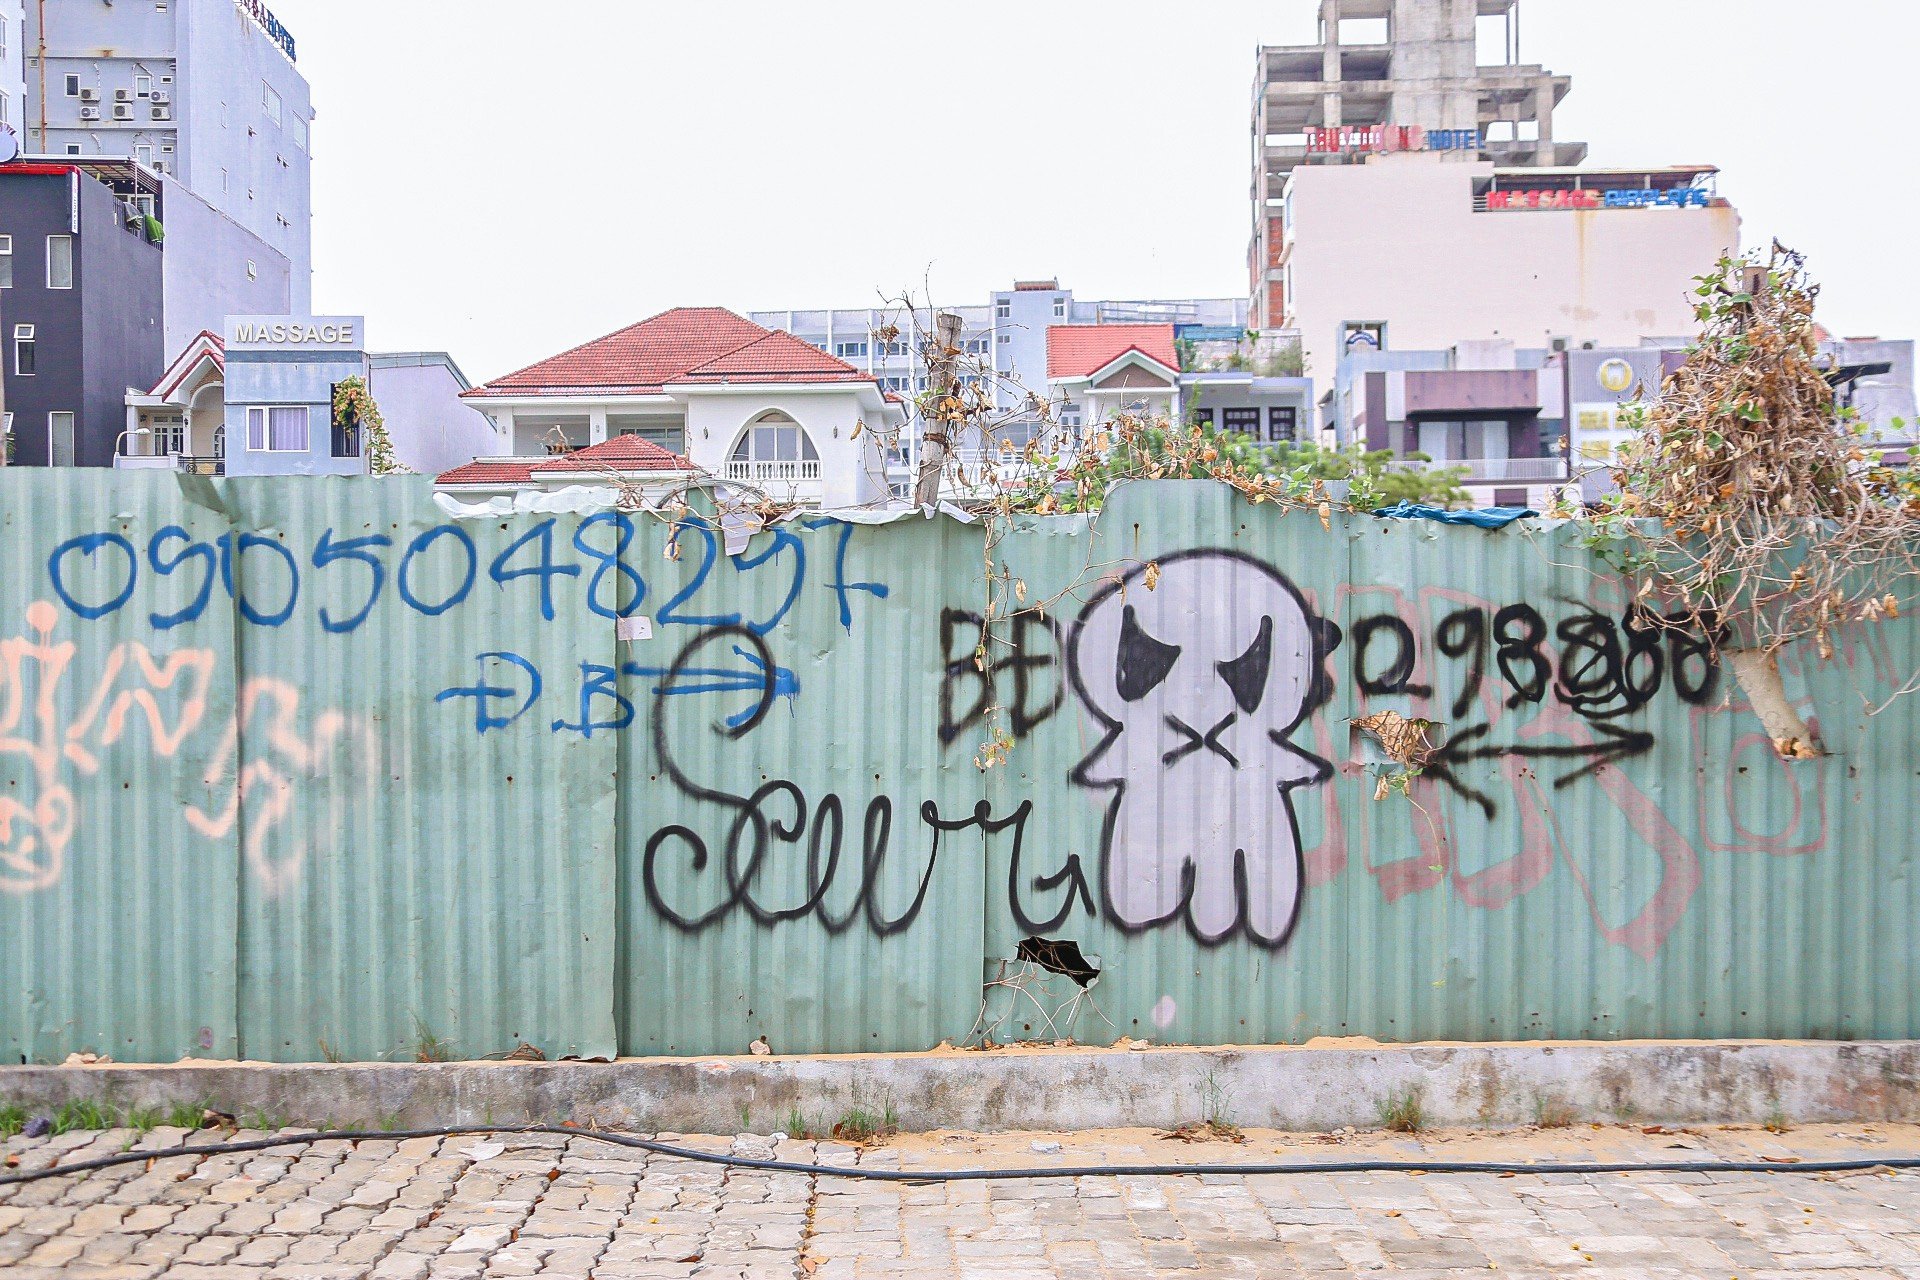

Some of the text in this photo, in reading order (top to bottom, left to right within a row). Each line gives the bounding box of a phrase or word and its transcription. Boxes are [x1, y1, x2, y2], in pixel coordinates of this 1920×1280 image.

[266, 8, 296, 62] HOTEL
[1428, 129, 1486, 150] HOTEL
[1486, 189, 1599, 209] MASSAGE
[235, 323, 354, 344] MASSAGE
